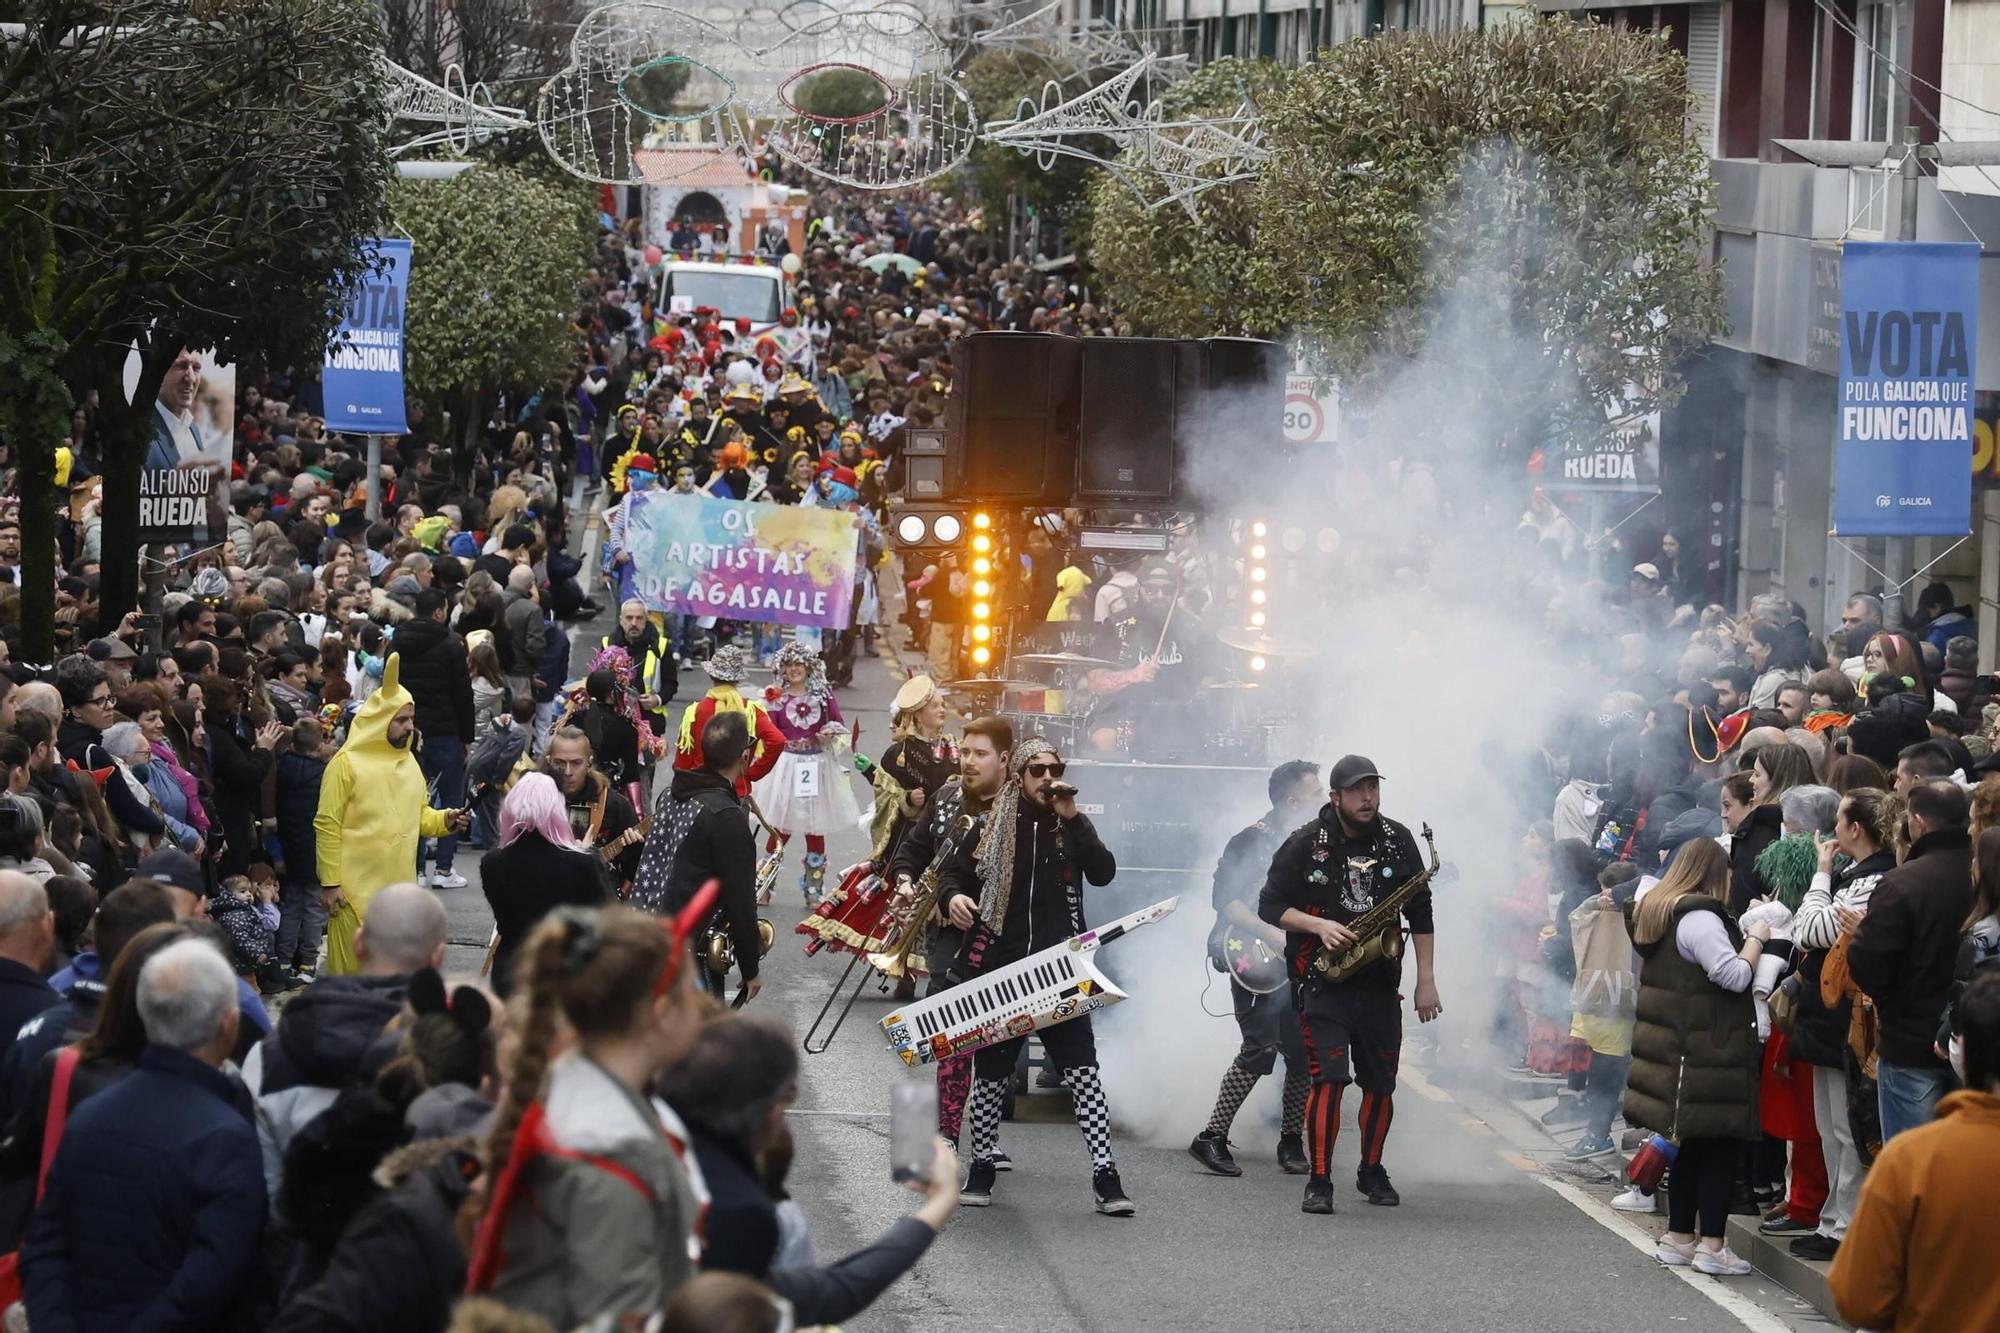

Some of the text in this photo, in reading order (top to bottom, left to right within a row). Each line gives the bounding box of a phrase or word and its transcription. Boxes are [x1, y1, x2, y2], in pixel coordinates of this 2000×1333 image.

[348, 284, 401, 329] OTA
[382, 331, 400, 347] QUE
[1845, 310, 1969, 378] VOTA
[1846, 381, 1968, 404] POLA GALICIA QUE
[1284, 411, 1312, 430] 30
[1843, 406, 1968, 441] FUNCIONA
[1564, 453, 1636, 479] RUEDA
[139, 469, 210, 495] ALFONSO
[139, 497, 208, 527] RUEDA
[1898, 497, 1932, 507] GALICIA
[722, 509, 757, 537] OS
[643, 575, 828, 616] DE AGASALLE
[801, 769, 810, 784] 2
[890, 1024, 909, 1040] FCK
[892, 1033, 912, 1048] CPS
